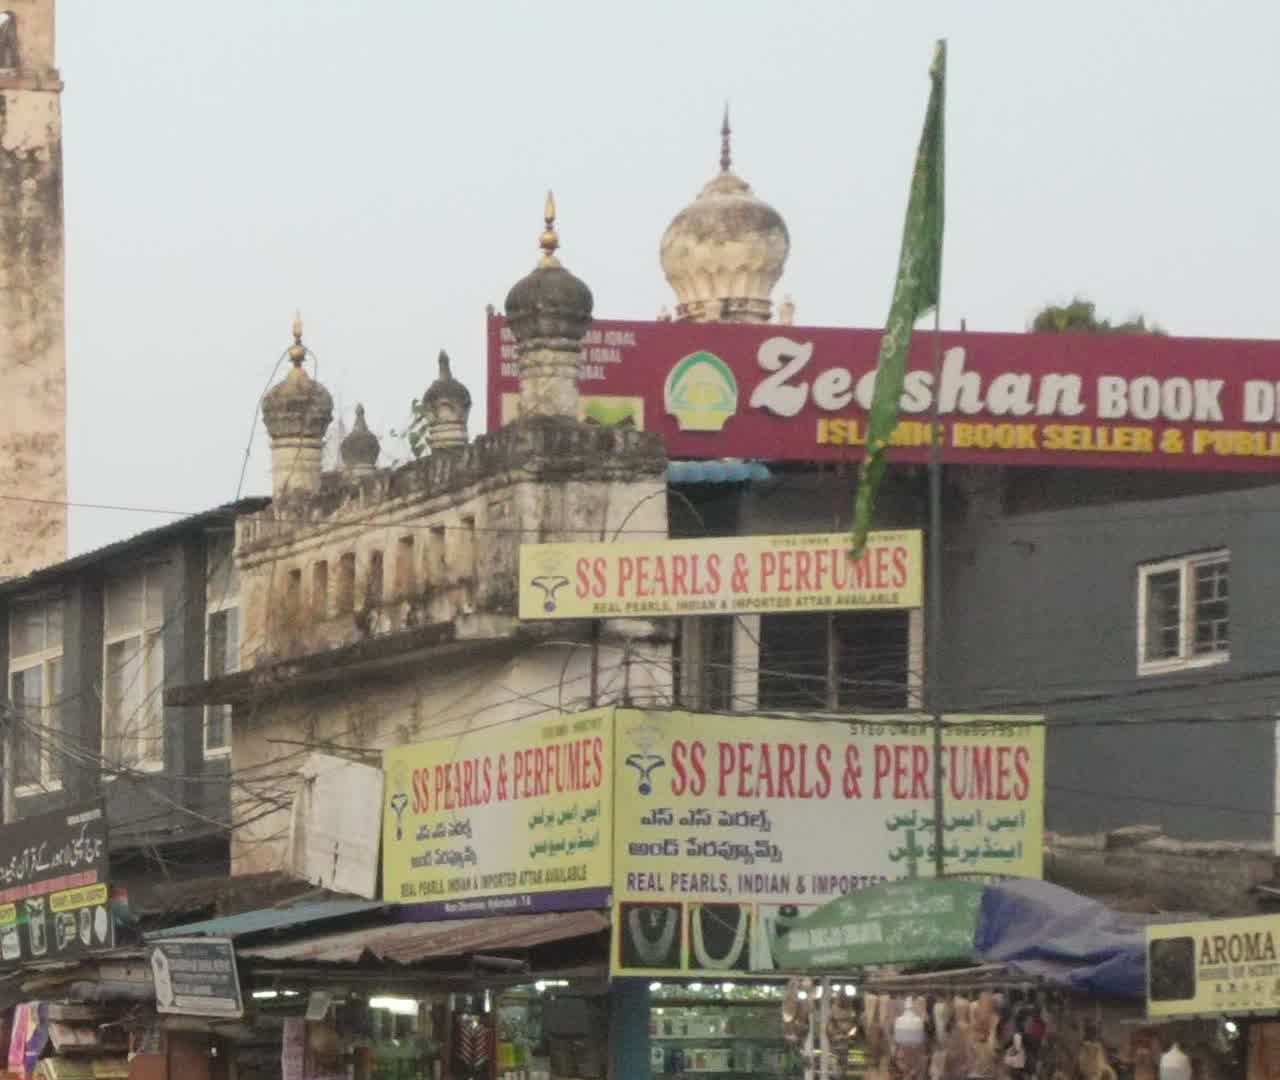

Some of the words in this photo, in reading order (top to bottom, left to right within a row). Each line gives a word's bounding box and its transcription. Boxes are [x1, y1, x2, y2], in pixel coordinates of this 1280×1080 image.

[1097, 376, 1225, 422] BOOK
[1243, 380, 1280, 423] D
[952, 422, 1037, 449] BOOK
[1041, 425, 1153, 453] SELLER
[1159, 428, 1184, 454] &
[576, 557, 607, 598] SS
[618, 553, 721, 598] PEARLS
[731, 552, 749, 593] &
[760, 546, 907, 592] PERFUMES
[411, 768, 430, 815] SS
[434, 755, 492, 812] PEARLS
[496, 752, 509, 802] &
[512, 736, 603, 800] PERFUMES
[671, 740, 707, 797] SS
[718, 742, 832, 799] PEARLS
[842, 744, 862, 799] &
[626, 873, 665, 893] REAL
[671, 874, 732, 896] PEARLS,
[738, 875, 790, 894] INDIAN
[796, 876, 806, 895] &
[1200, 930, 1277, 965] AROMA
